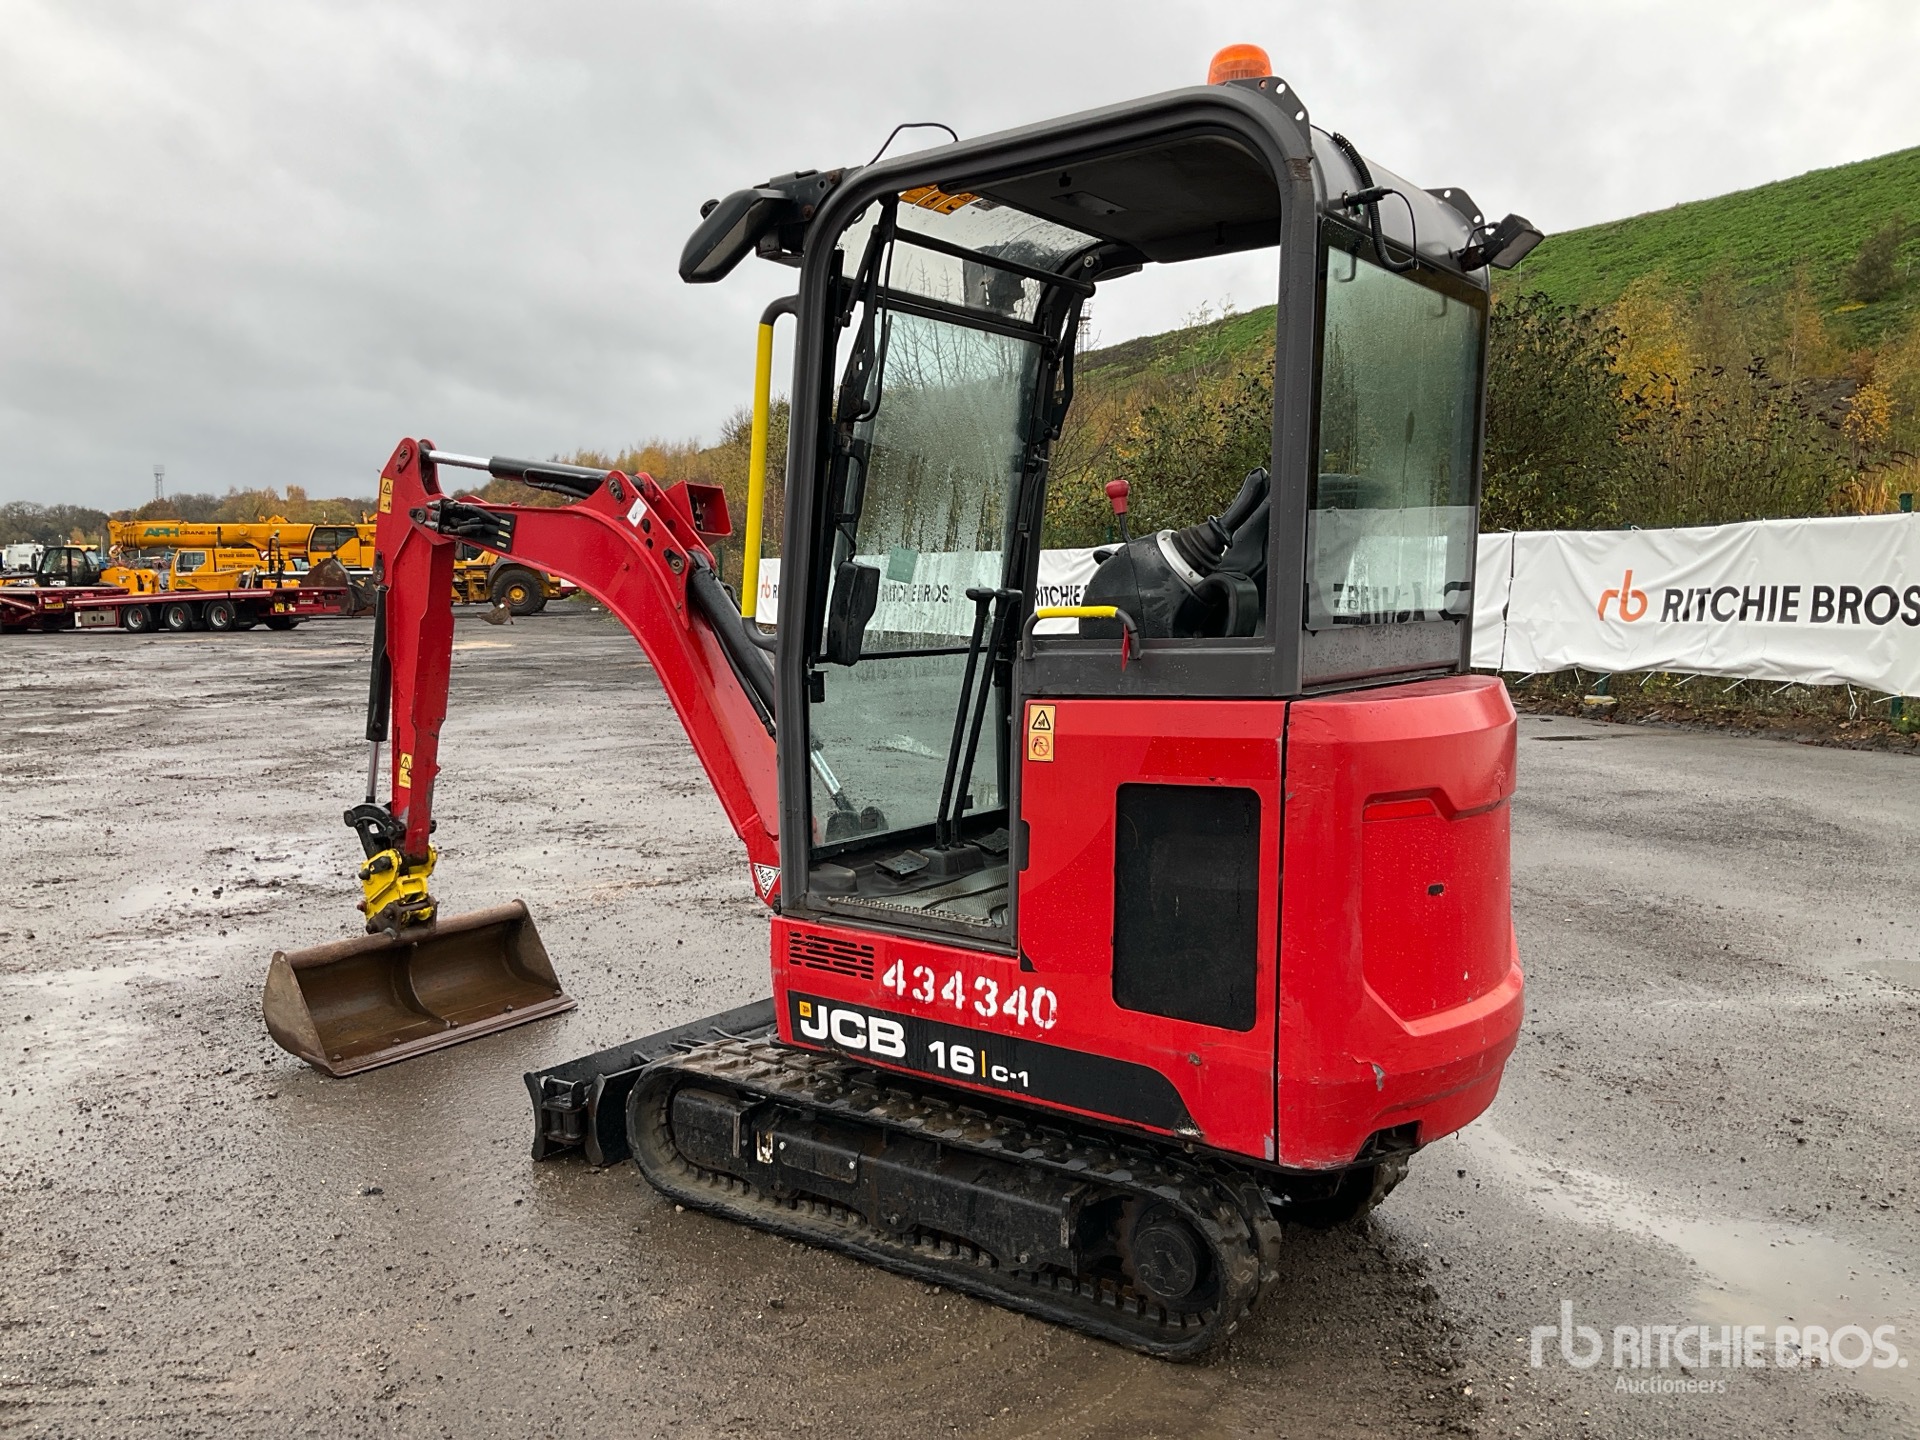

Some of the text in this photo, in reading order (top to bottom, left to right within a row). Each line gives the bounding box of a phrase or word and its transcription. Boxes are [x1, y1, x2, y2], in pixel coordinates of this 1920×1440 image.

[1660, 585, 1801, 623] RITCHIE
[882, 958, 1058, 1030] 434340
[800, 1003, 906, 1058] JCB
[928, 1041, 975, 1075] 16
